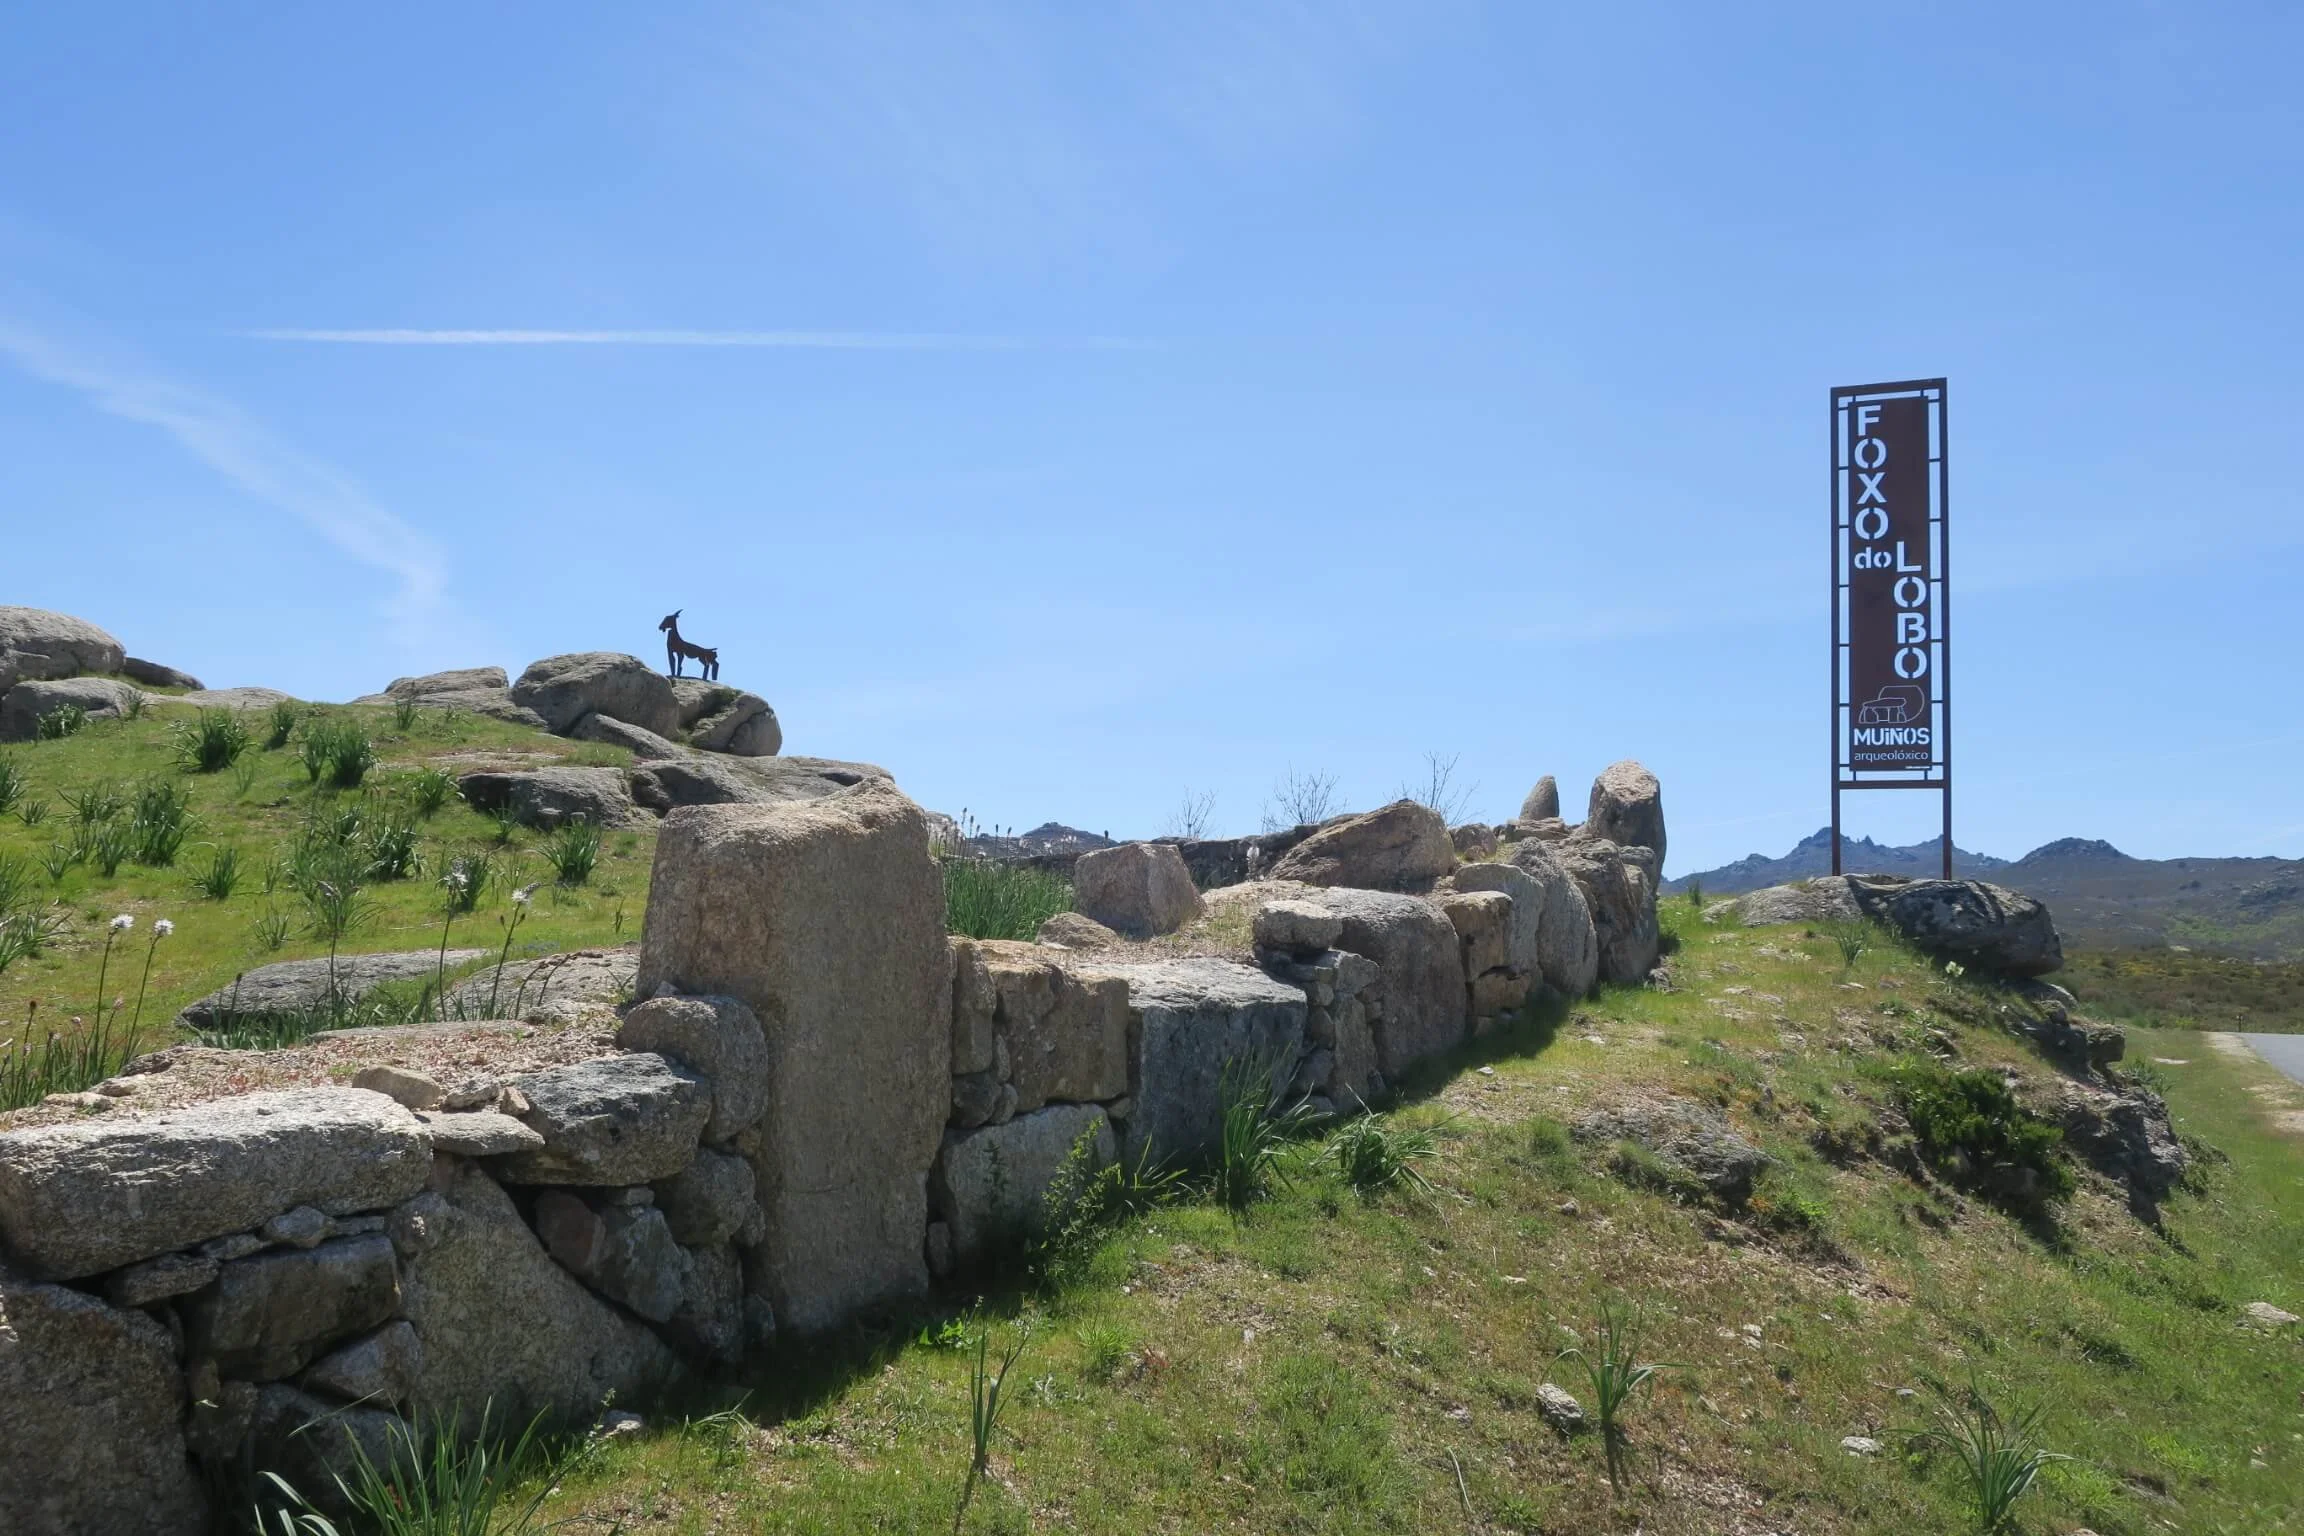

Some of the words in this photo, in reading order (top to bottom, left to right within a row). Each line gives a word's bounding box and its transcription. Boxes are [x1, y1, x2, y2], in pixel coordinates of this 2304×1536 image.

[1854, 404, 1889, 540] FOXO
[1854, 547, 1892, 569] do
[1894, 541, 1927, 679] LOBO
[1854, 750, 1929, 763] arqueolóxico
